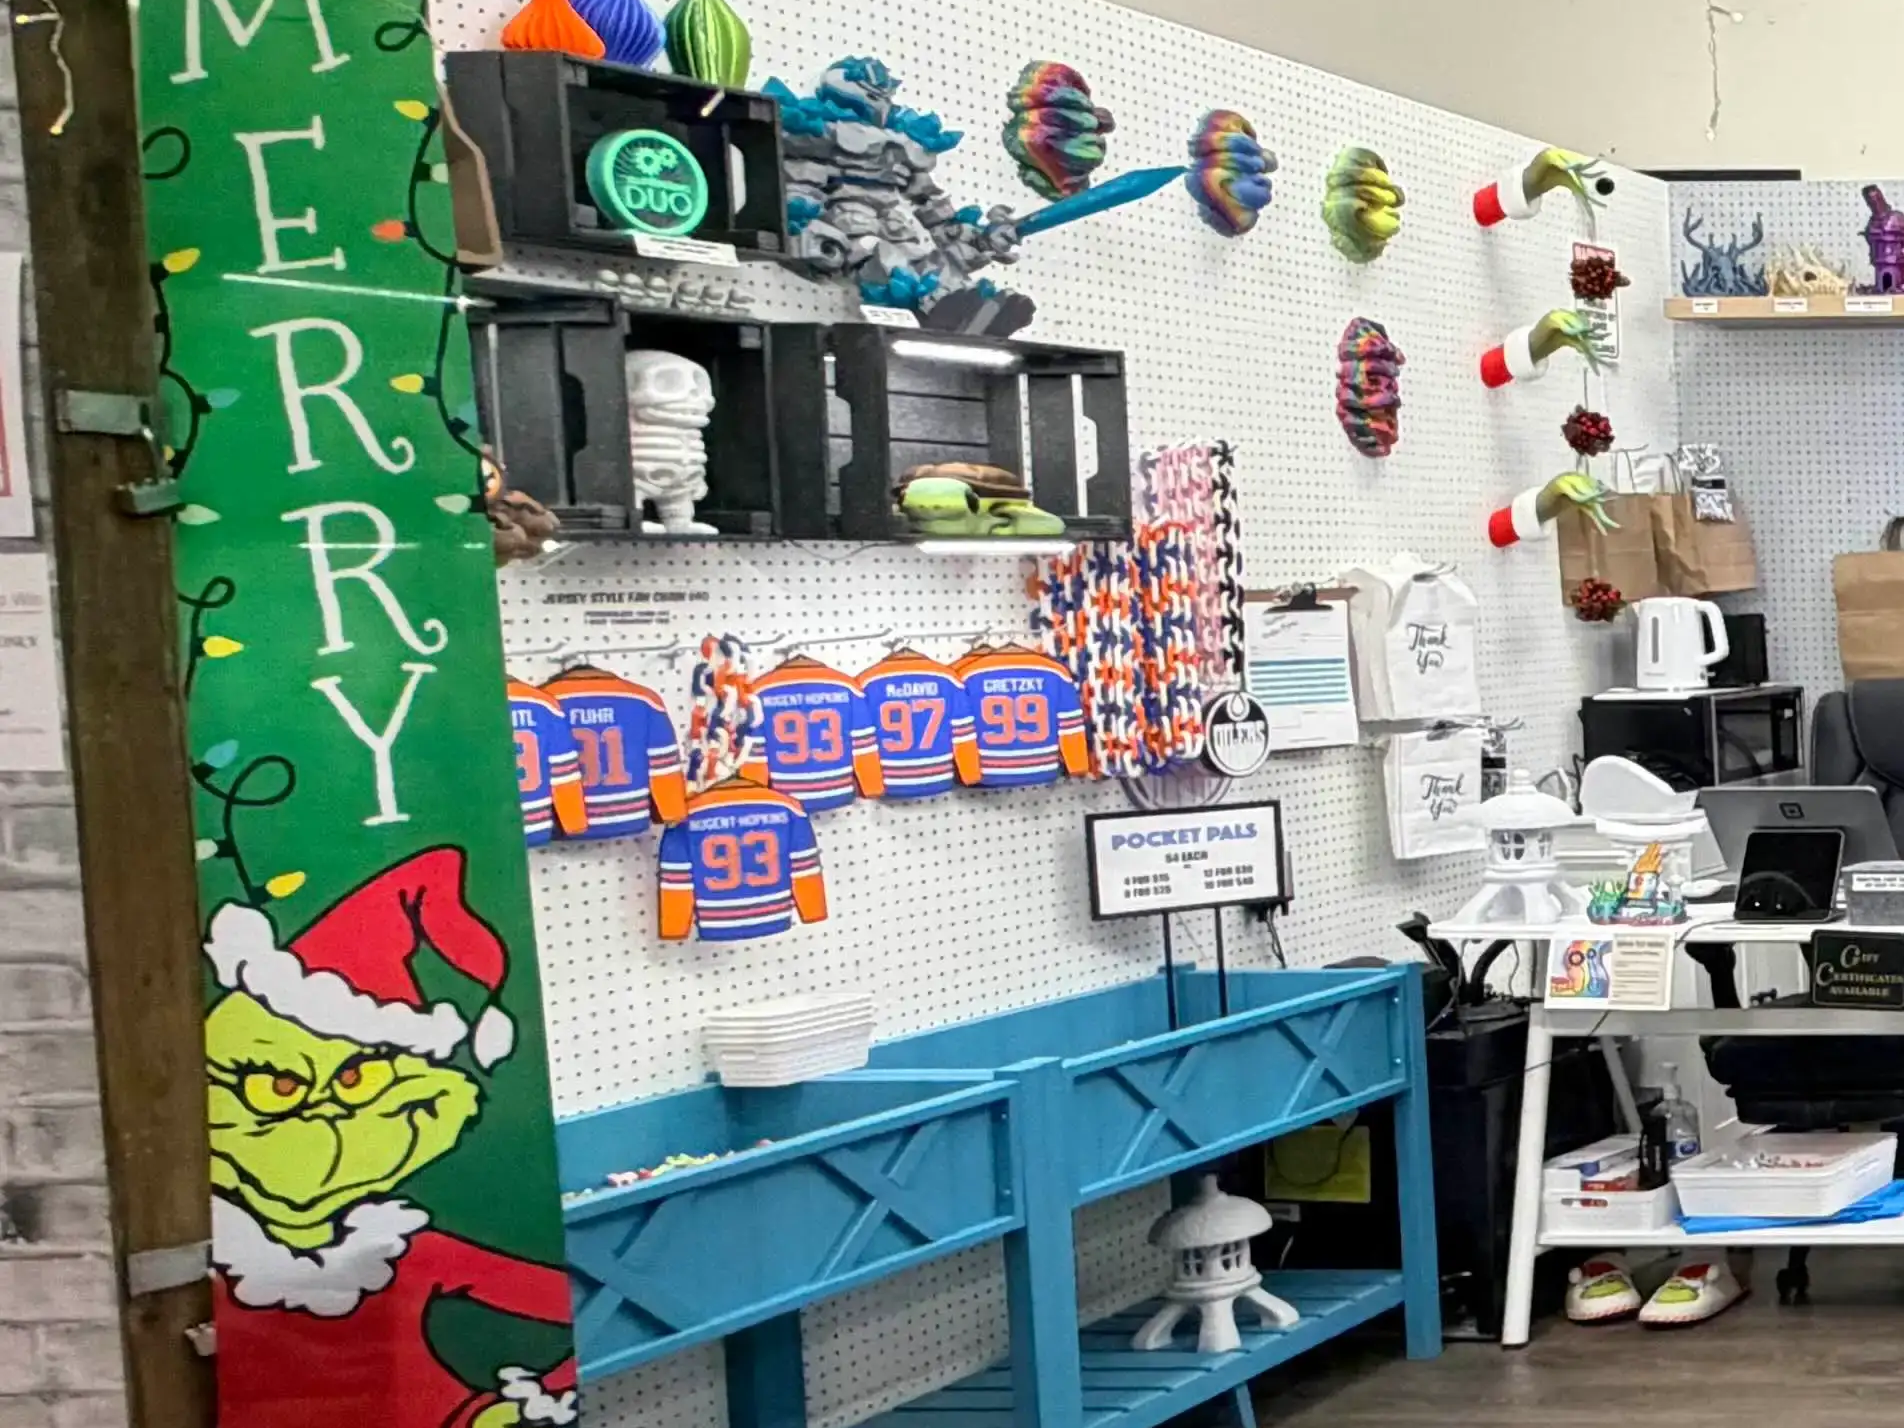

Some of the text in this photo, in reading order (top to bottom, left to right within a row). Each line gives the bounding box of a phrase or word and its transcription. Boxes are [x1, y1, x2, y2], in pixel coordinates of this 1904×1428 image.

[625, 184, 693, 217] DUO
[1405, 621, 1454, 652] Thank
[1416, 649, 1446, 675] You
[886, 681, 939, 698] McDAVID
[983, 677, 1045, 694] GRETZKY
[569, 707, 615, 725] FUHR
[880, 698, 945, 752] 97
[980, 694, 1051, 745] 99
[772, 708, 843, 765] 93
[1420, 772, 1468, 801] Thank
[1430, 797, 1458, 822] You
[1111, 822, 1258, 851] POCKET PALS
[701, 830, 780, 892] 93
